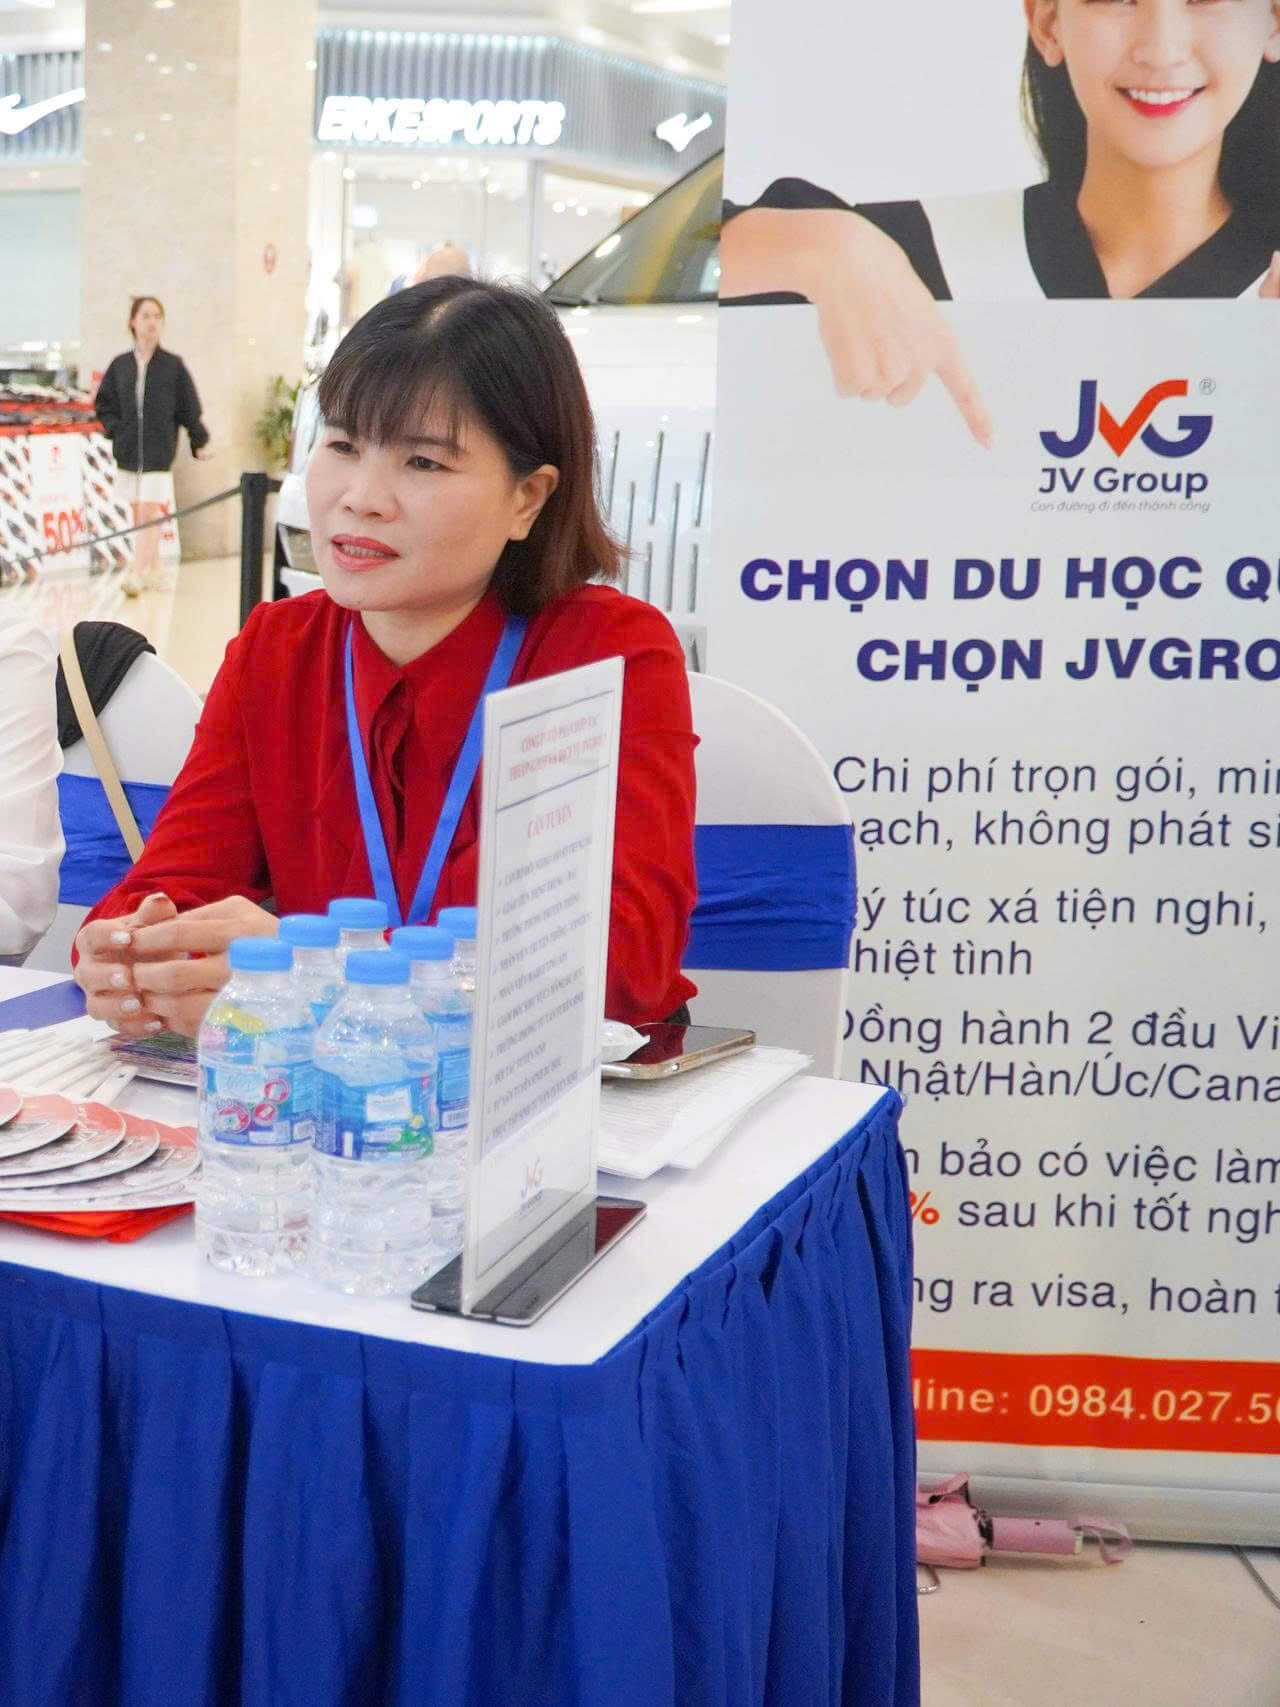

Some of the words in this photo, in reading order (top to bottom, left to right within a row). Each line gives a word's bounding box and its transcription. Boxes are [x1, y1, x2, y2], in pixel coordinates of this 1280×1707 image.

[317, 95, 566, 146] ERKESPORTS
[1039, 379, 1213, 458] JVG
[1038, 467, 1086, 494] JV
[1093, 466, 1209, 500] Group
[740, 558, 928, 612] CHỌN
[953, 558, 1042, 600] DU
[1064, 556, 1203, 611] HỌC
[1226, 556, 1280, 603] Q
[856, 638, 1043, 692] CHỌN
[1065, 637, 1280, 682] JVGRO
[833, 756, 909, 793] Chi
[927, 756, 1000, 802] phí
[1012, 759, 1096, 799] trọn
[1115, 756, 1197, 802] gói,
[1218, 758, 1280, 795] mi
[851, 810, 953, 852] ạch,
[973, 810, 1110, 854] không
[1128, 810, 1231, 854] phát
[862, 887, 886, 932] ý
[903, 887, 970, 924] túc
[988, 888, 1039, 924] xá
[1057, 888, 1135, 929] tiện
[1156, 890, 1267, 935] nghi,
[854, 939, 937, 981] hiệt
[953, 939, 1032, 976] tình
[961, 1010, 1070, 1046] hành
[1087, 1011, 1113, 1045] 2
[1131, 1006, 1216, 1049] đầu
[1236, 1014, 1280, 1051] Vi
[940, 1138, 1022, 1178] bảo
[1038, 1141, 1088, 1179] có
[1106, 1145, 1198, 1190] việc
[957, 1200, 1036, 1228] sau
[1055, 1194, 1116, 1229] khi
[1135, 1192, 1191, 1232] tốt
[973, 1279, 1015, 1308] ra
[1032, 1273, 1129, 1315] visa,
[1149, 1277, 1256, 1314] hoàn
[913, 1379, 1010, 1416] line:
[1028, 1382, 1280, 1424] 0984.027.5
